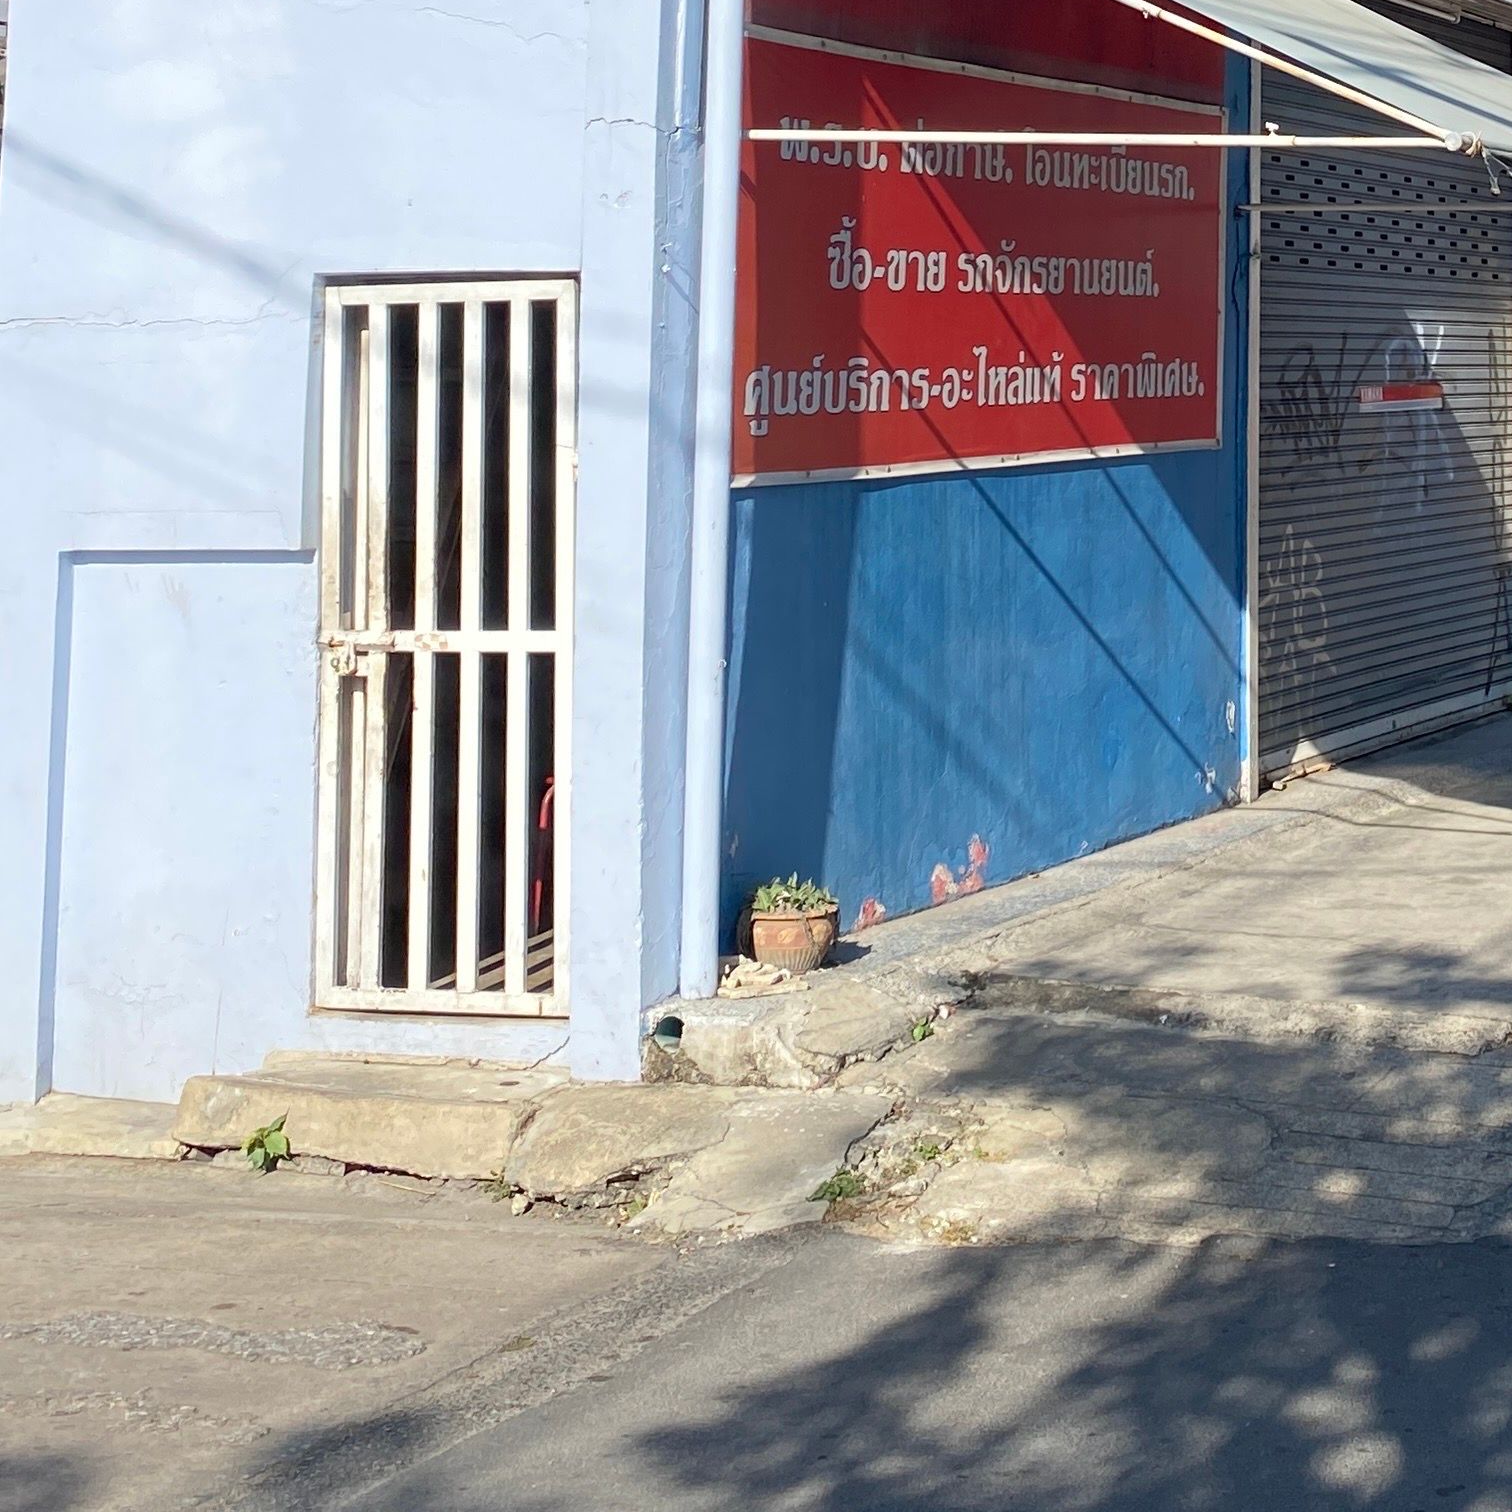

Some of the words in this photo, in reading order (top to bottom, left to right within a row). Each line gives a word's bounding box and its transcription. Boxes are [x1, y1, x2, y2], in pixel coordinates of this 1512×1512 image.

[828, 216, 948, 292] ซื้อ-ขาย
[743, 345, 1064, 437] ศูนย์บริการ-อะไหล่แท้
